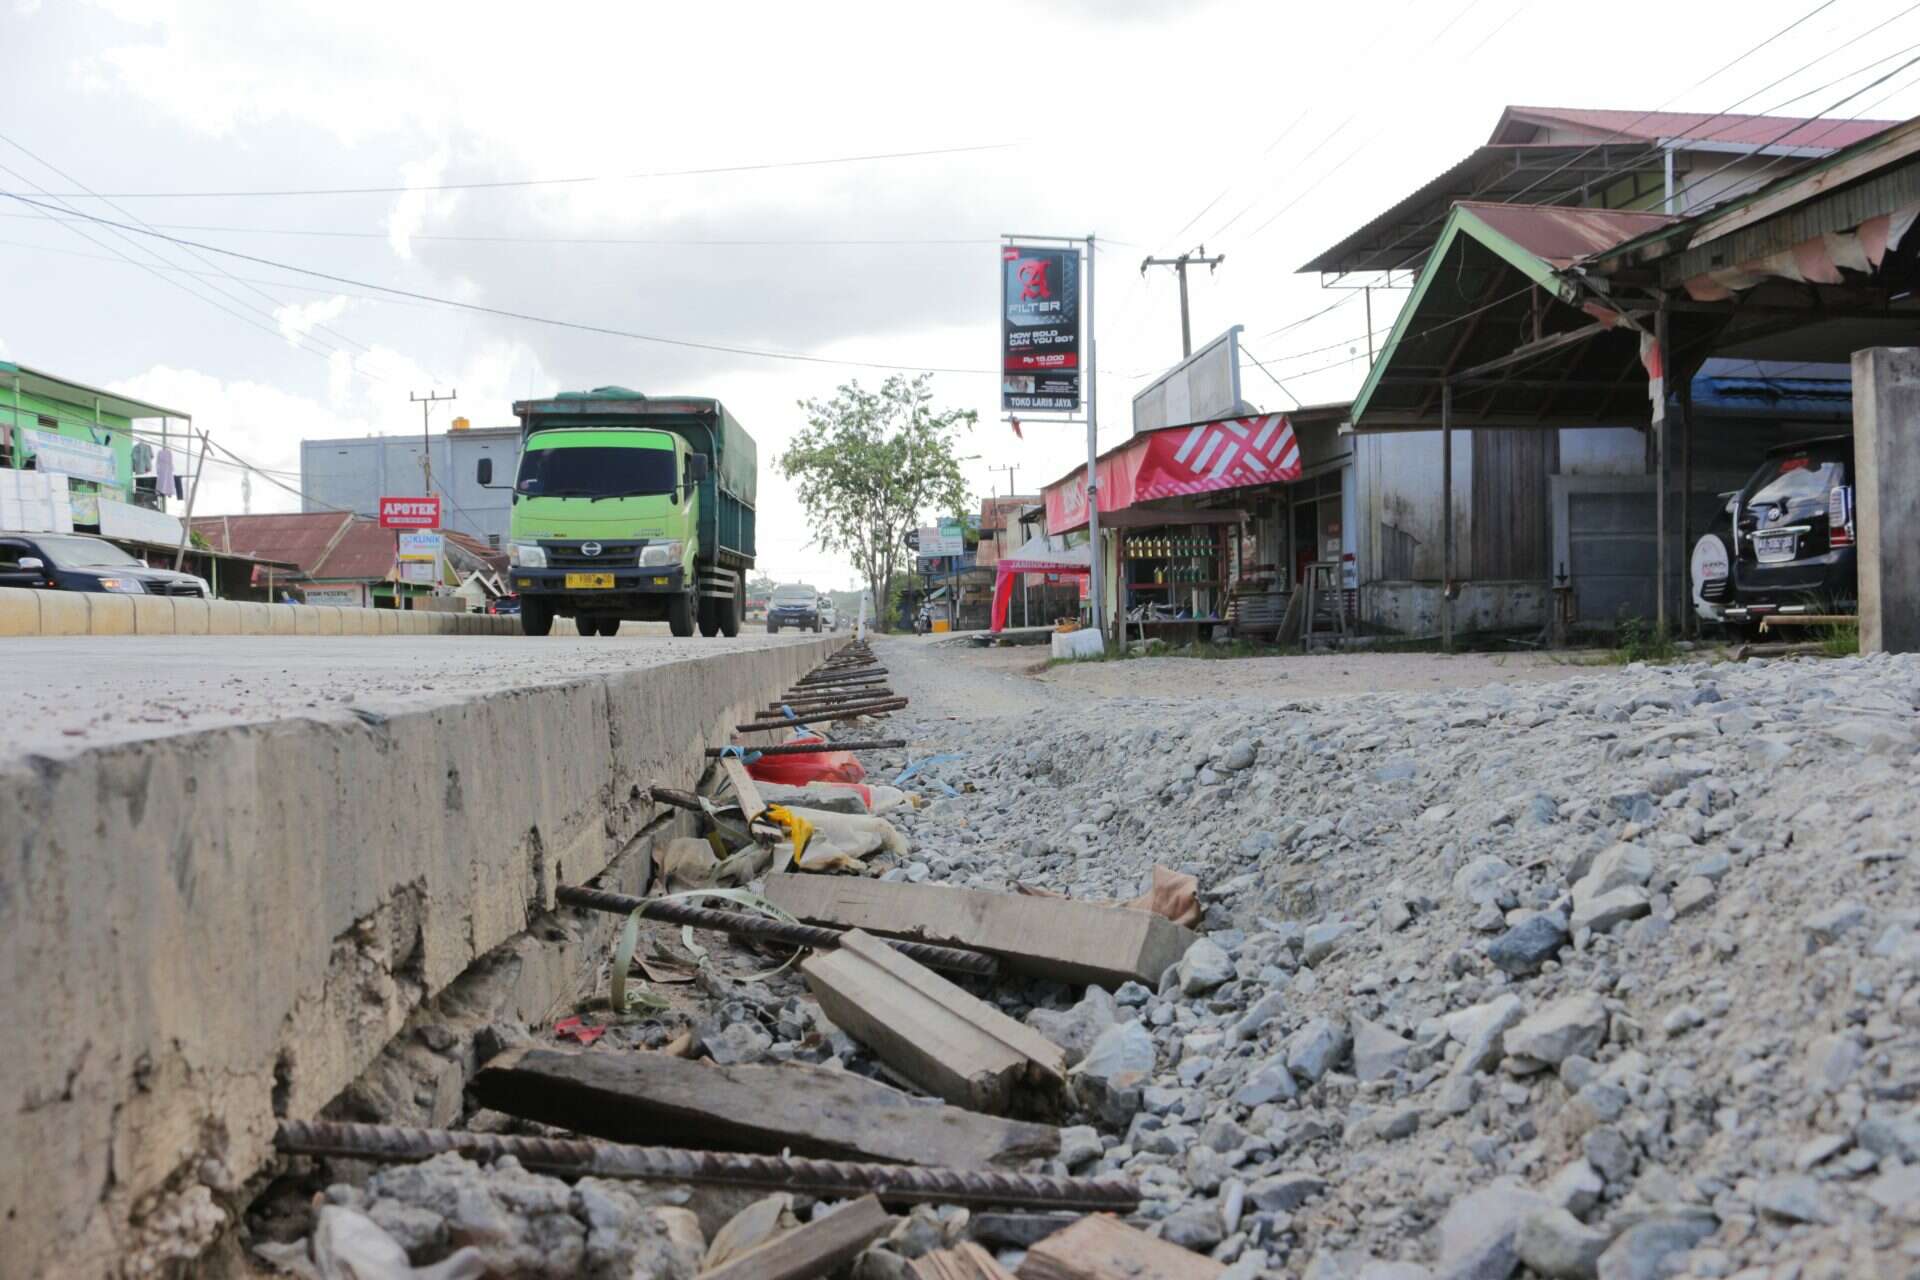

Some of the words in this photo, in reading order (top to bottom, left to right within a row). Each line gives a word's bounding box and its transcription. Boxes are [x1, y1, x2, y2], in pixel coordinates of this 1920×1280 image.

[1009, 302, 1060, 314] FILTER
[1011, 397, 1031, 407] TOKO
[1032, 398, 1053, 407] LARIS
[1054, 398, 1072, 408] JAYA
[383, 503, 437, 515] APOTEK
